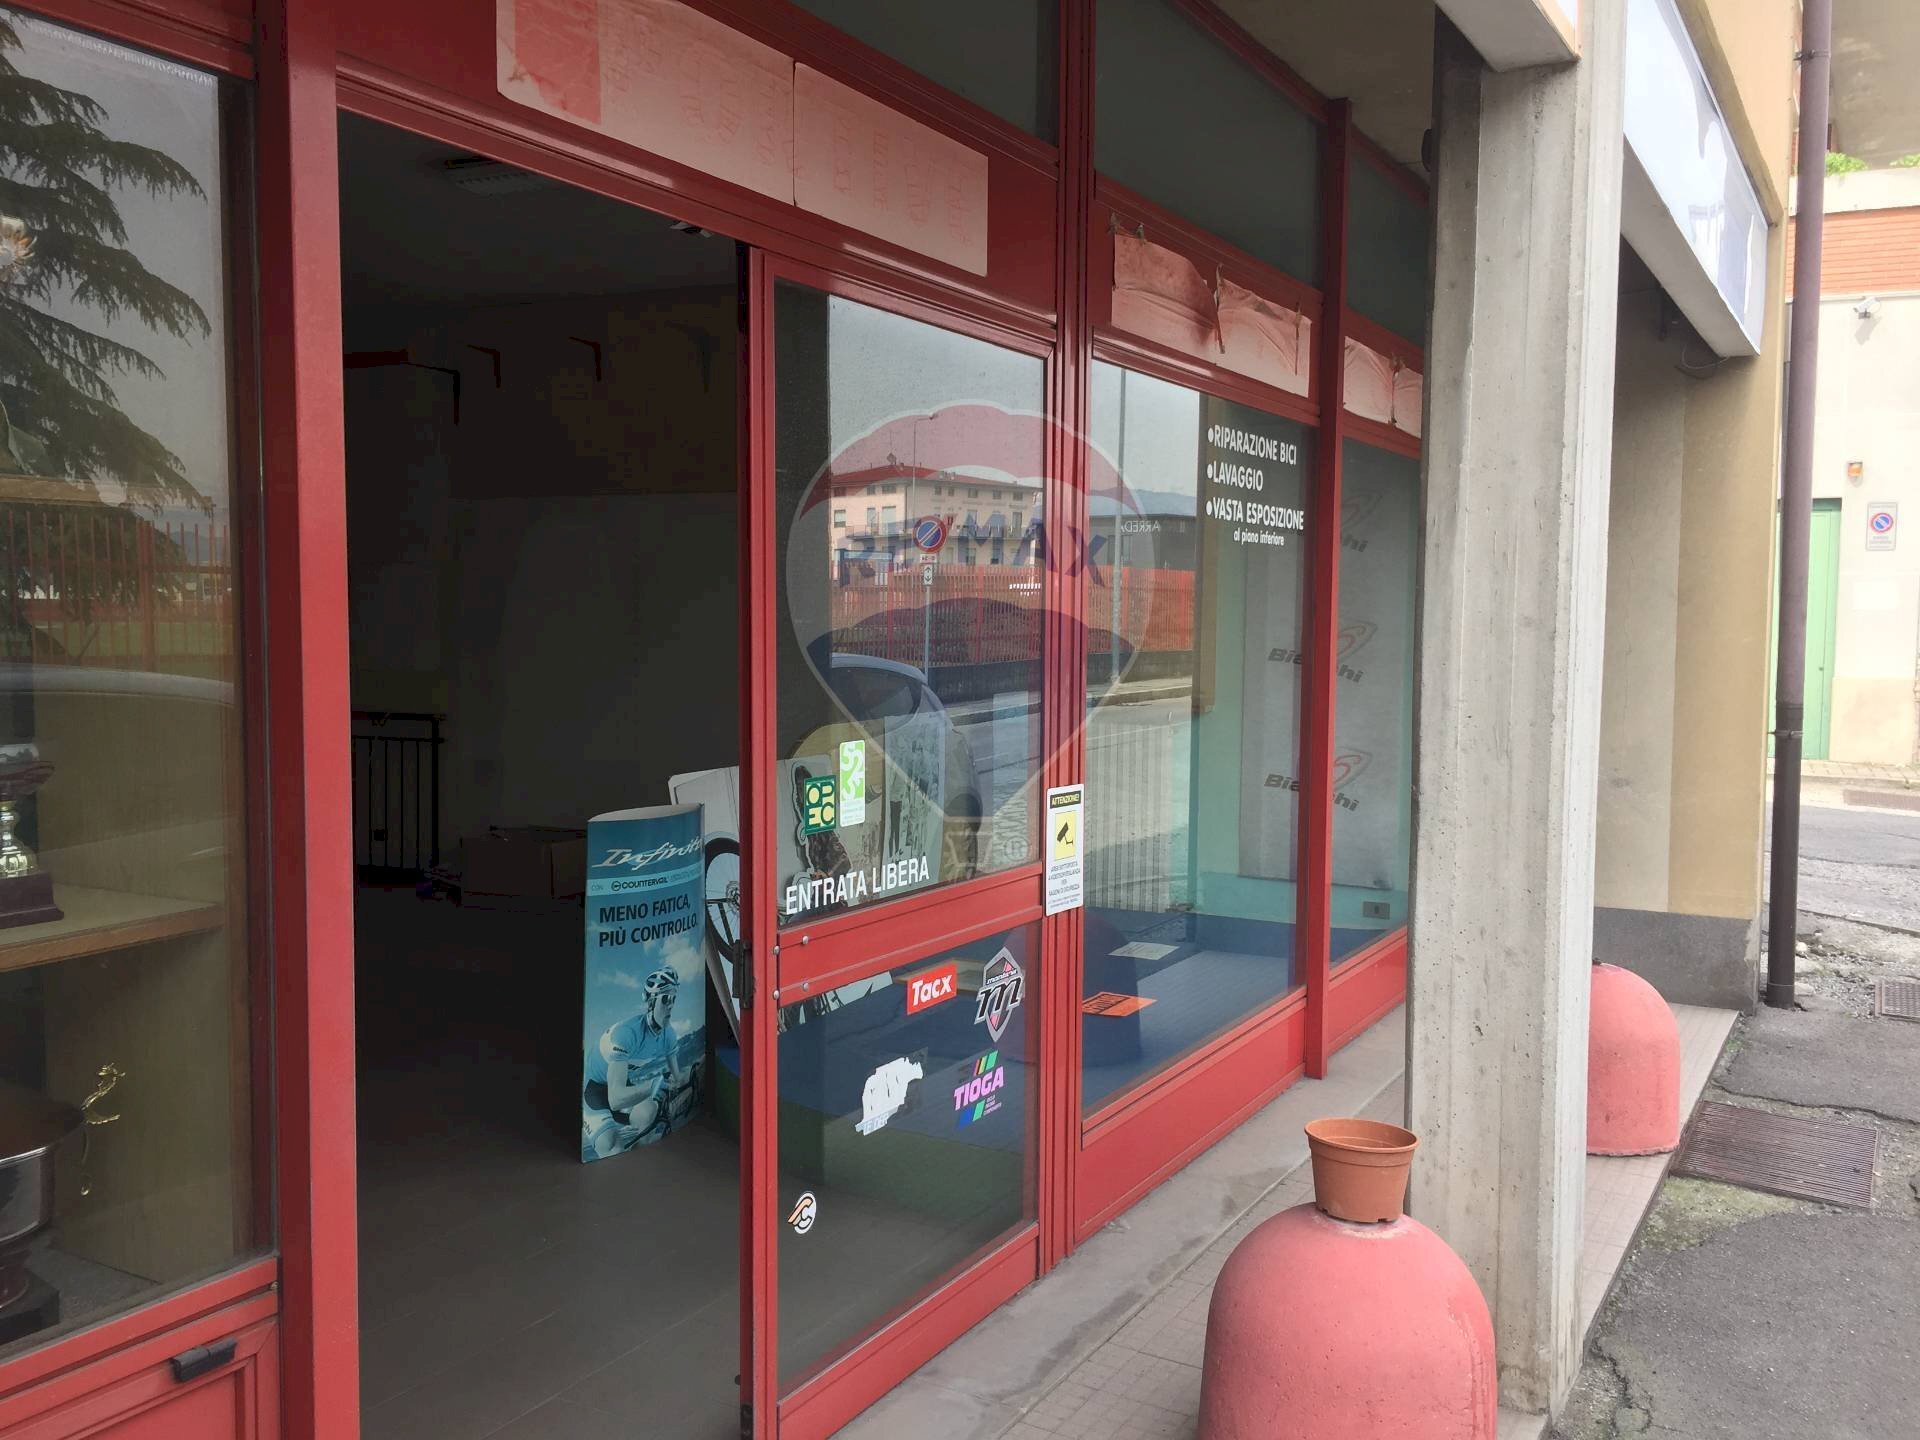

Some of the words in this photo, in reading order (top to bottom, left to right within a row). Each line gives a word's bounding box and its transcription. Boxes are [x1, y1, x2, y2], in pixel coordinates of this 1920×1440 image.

[1214, 424, 1278, 461] RIPARAZIONE
[1279, 441, 1297, 465] BICI
[1213, 460, 1264, 491] LAVAGGIO
[1213, 497, 1243, 522] VASTA
[1246, 502, 1304, 530] ESPOSIZIONE
[1233, 527, 1240, 541] al
[1241, 528, 1259, 545] piano
[1260, 530, 1285, 546] inferiore
[786, 870, 867, 915] ENTRATA
[873, 856, 929, 893] LIBERA
[600, 903, 648, 923] MENO
[652, 894, 691, 917] FATICA,
[599, 927, 626, 947] PIÙ
[912, 975, 952, 1005] Tacx
[954, 1066, 1004, 1110] TIOGA
